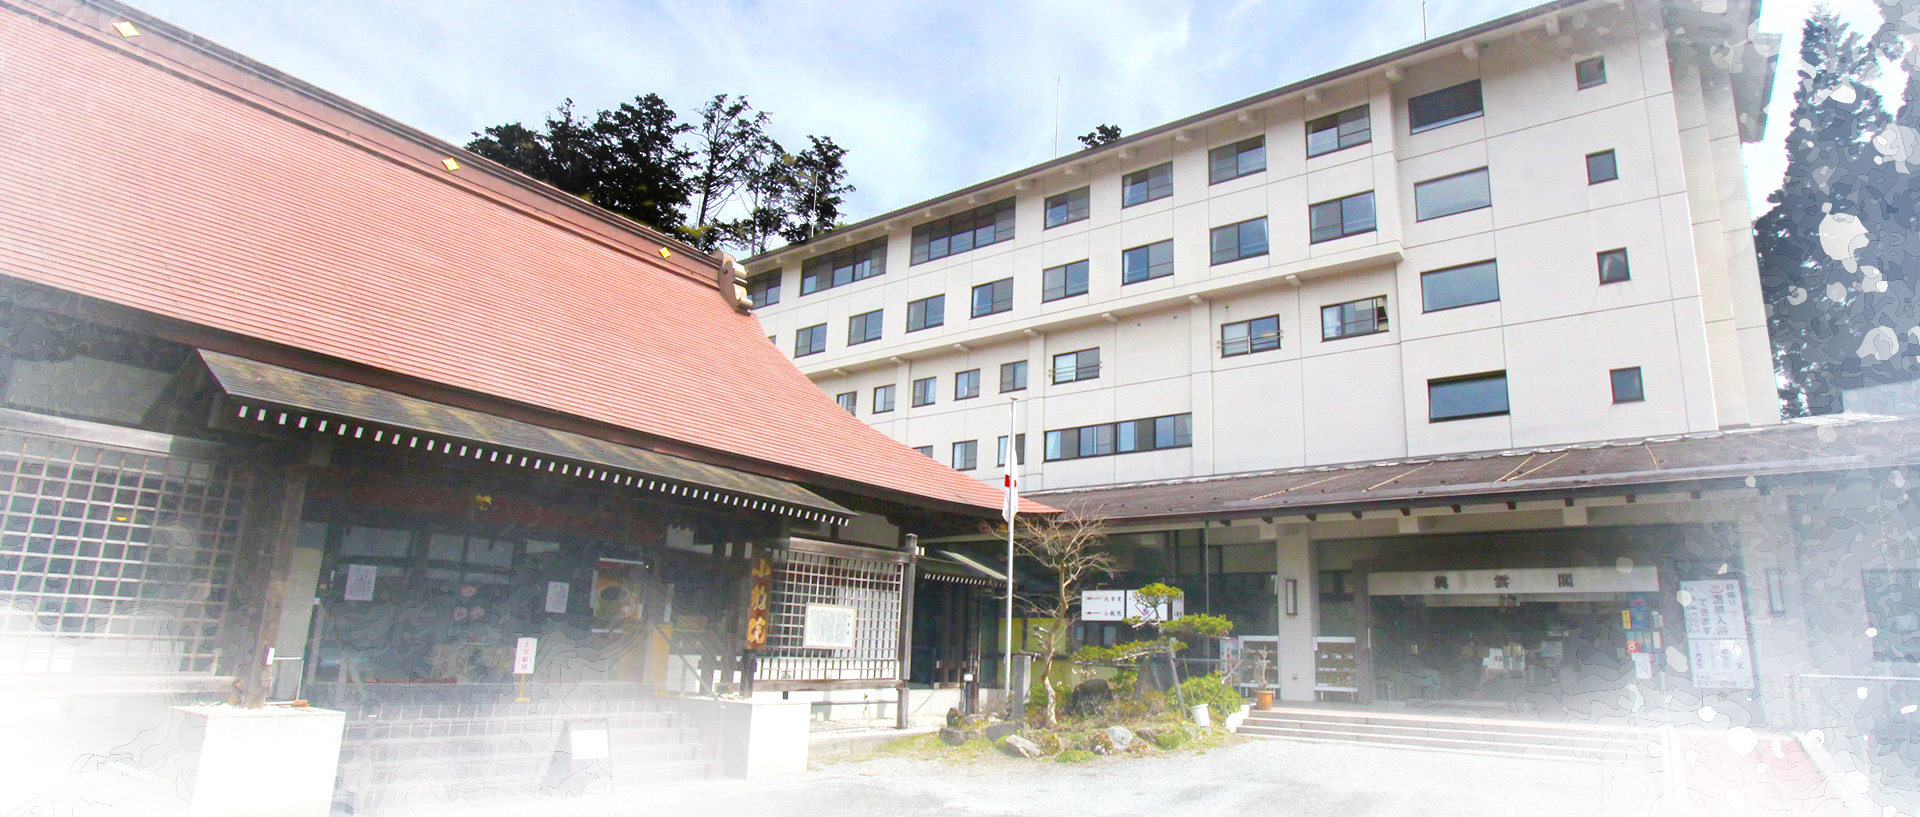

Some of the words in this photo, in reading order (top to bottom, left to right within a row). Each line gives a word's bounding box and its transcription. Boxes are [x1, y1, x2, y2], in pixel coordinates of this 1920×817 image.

[1698, 598, 1711, 635] できます
[1712, 594, 1728, 635] 温泉入浴
